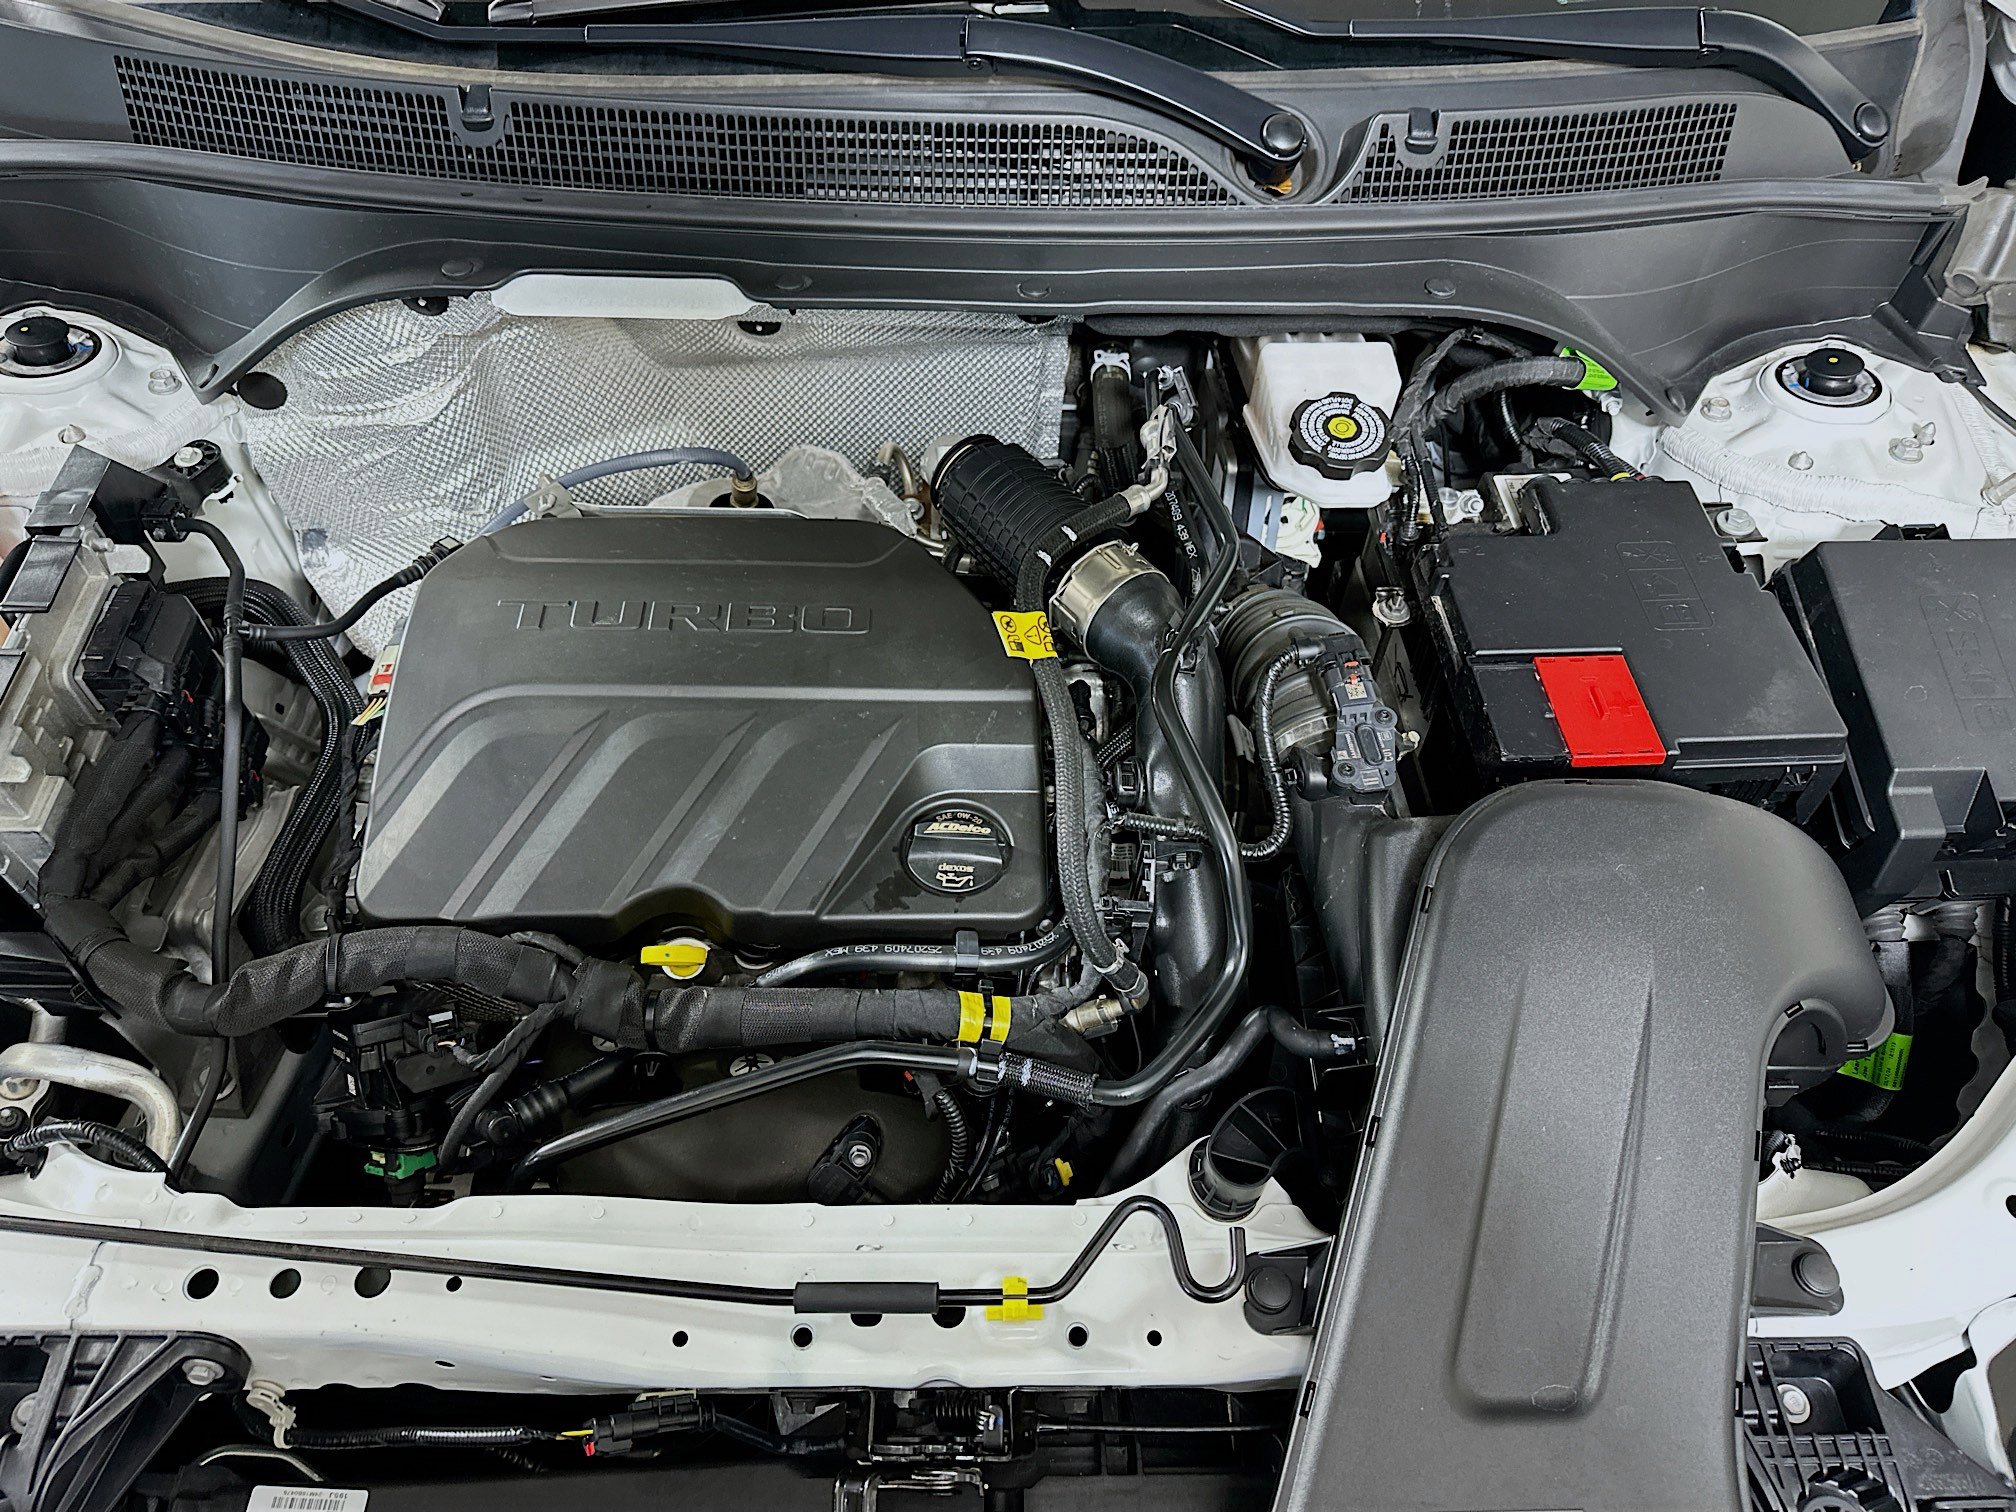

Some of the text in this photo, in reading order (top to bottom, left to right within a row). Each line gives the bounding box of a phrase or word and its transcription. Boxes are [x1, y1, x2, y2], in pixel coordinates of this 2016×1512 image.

[1176, 523, 1190, 541] 439
[1184, 540, 1198, 559] MEX
[497, 599, 873, 635] TURBO
[935, 812, 983, 825] SAE 0W-20
[924, 822, 992, 835] ACDelco
[938, 863, 975, 873] dexos
[824, 945, 850, 957] MEX
[854, 944, 879, 953] 439
[884, 944, 943, 954] 25207409
[980, 947, 1003, 956] 439
